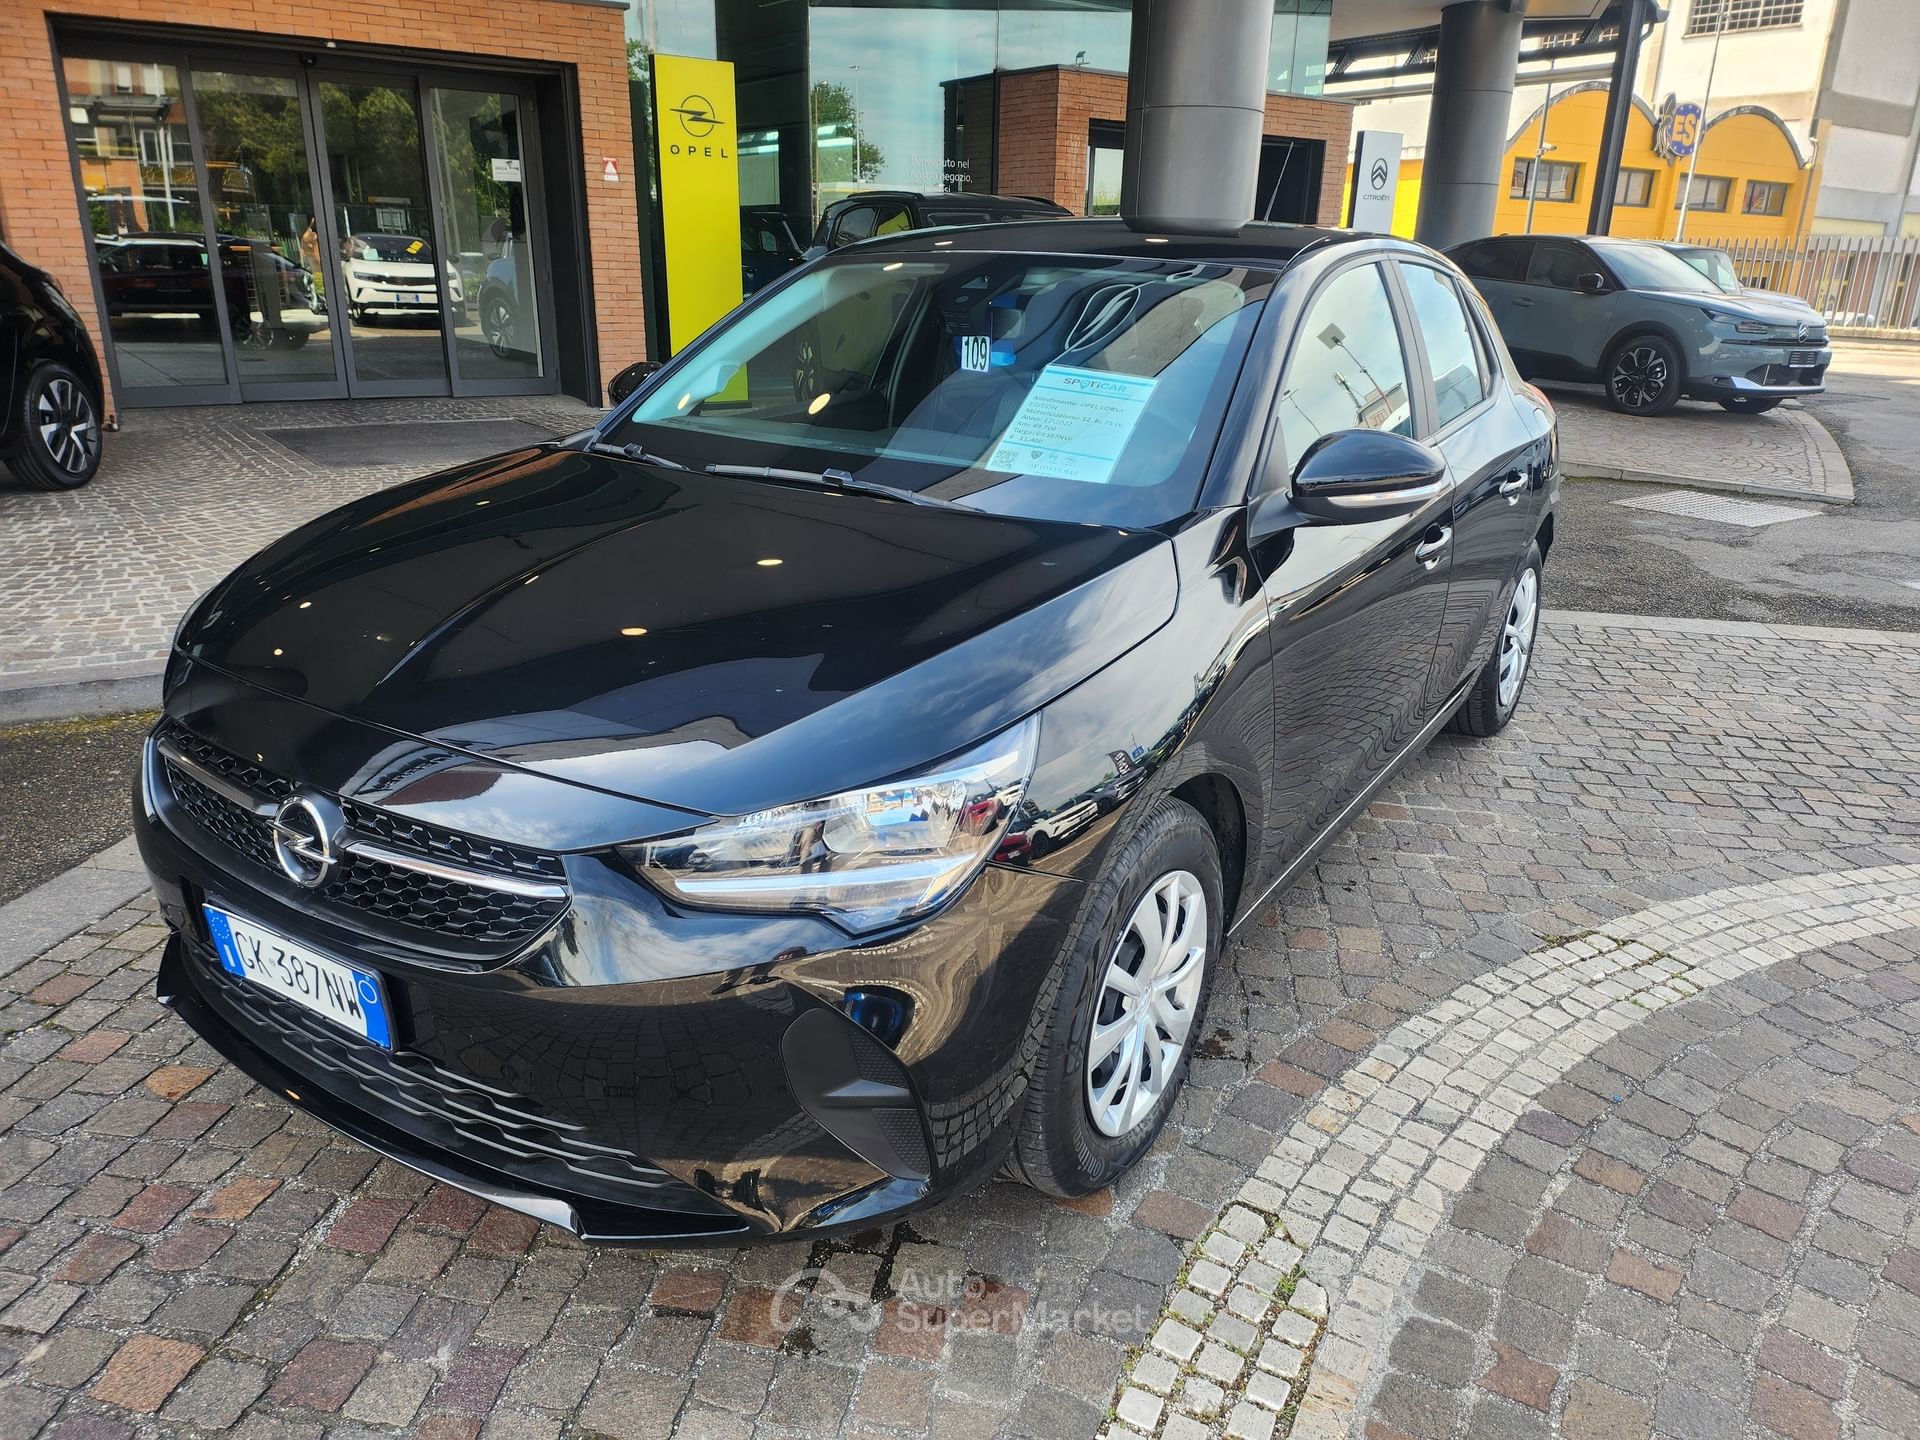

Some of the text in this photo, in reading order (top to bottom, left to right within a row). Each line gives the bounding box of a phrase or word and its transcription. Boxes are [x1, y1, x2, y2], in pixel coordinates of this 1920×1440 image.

[670, 144, 729, 159] OPEL
[957, 159, 970, 169] nel
[940, 172, 973, 184] negozio,
[965, 336, 989, 371] 109
[1081, 402, 1098, 410] OPEL
[1100, 405, 1124, 413] CORSA
